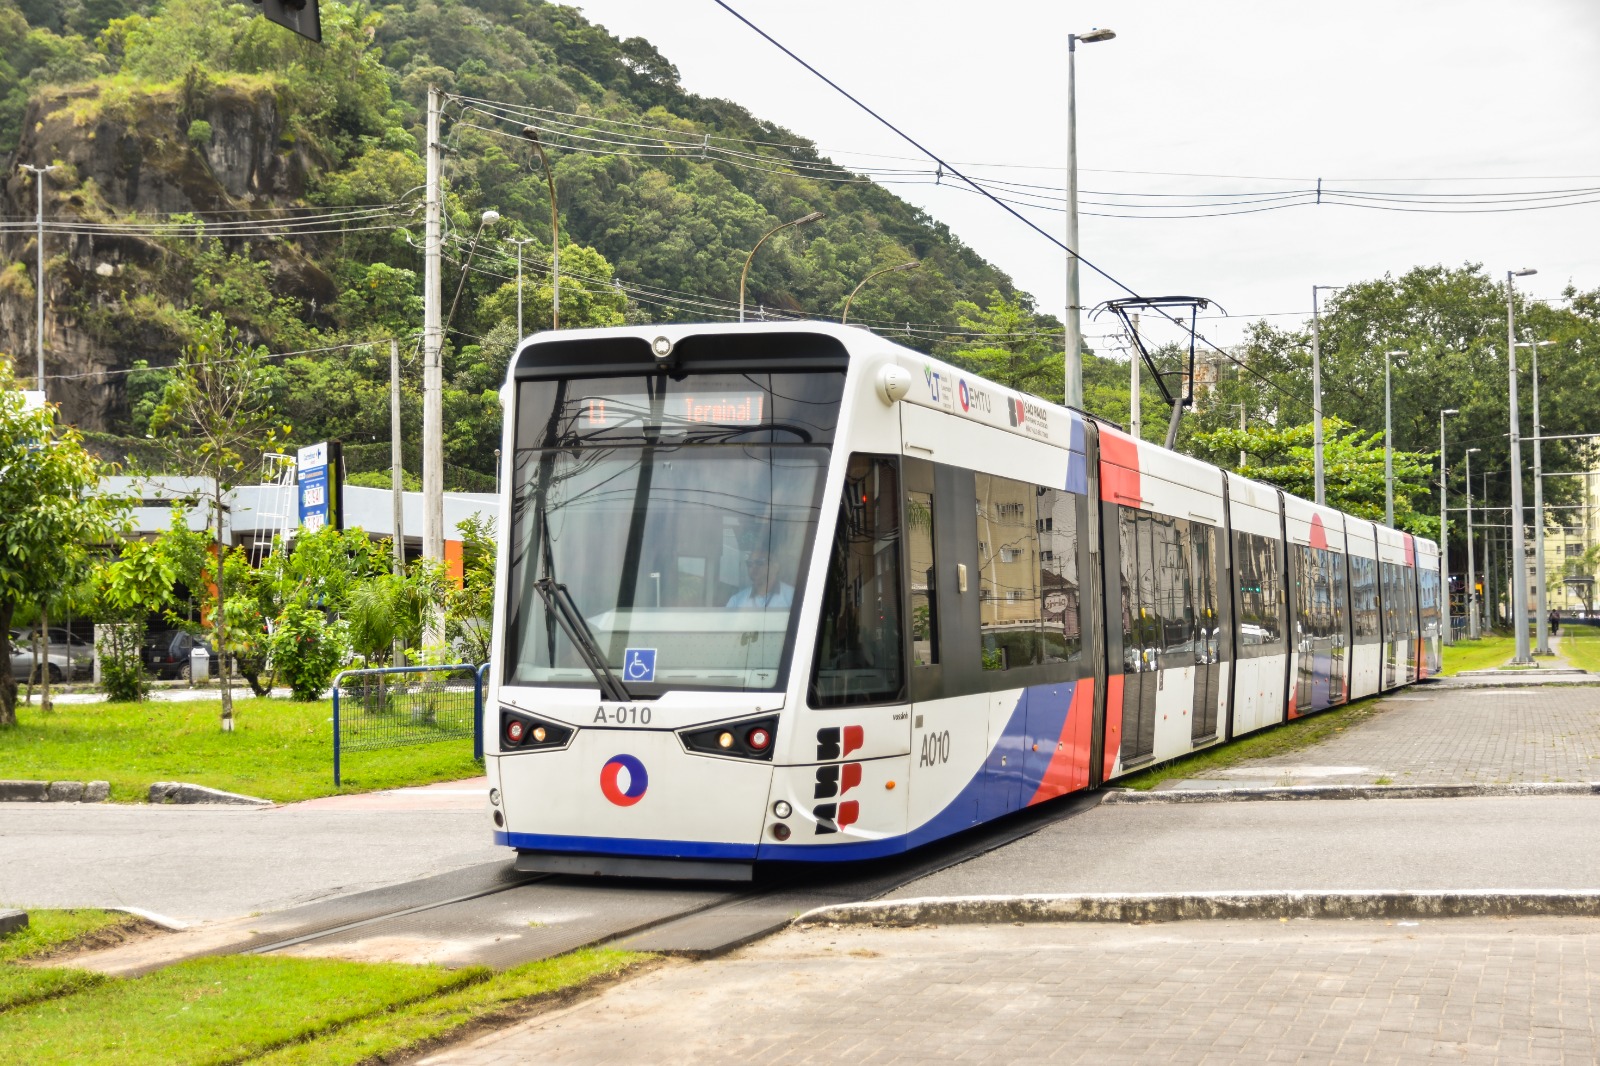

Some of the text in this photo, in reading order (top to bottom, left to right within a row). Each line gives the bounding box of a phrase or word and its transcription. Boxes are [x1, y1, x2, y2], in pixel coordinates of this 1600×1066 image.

[685, 396, 751, 422] Terminal
[969, 387, 991, 414] EMTU
[593, 705, 652, 725] A-010
[919, 729, 950, 769] A010
